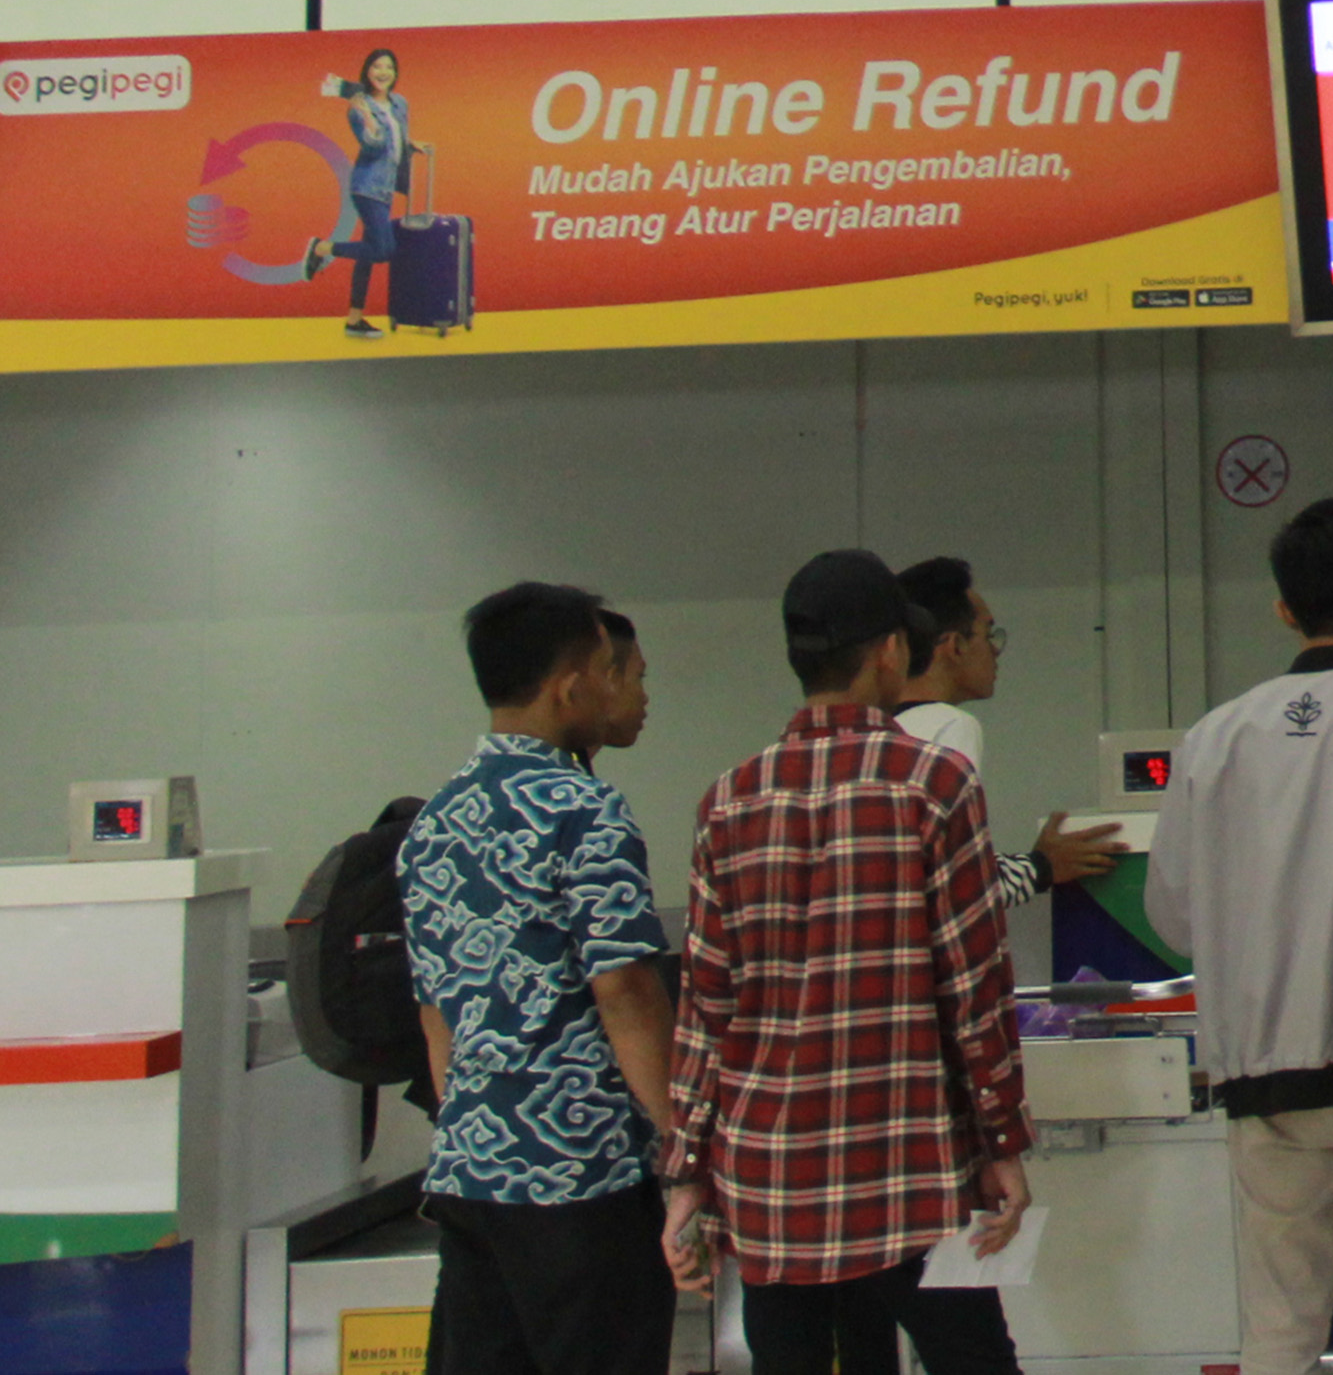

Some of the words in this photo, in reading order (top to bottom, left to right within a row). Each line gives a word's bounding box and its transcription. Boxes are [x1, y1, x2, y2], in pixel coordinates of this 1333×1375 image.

[35, 65, 183, 103] pegipegi
[531, 68, 824, 144] Online
[853, 51, 1183, 132] Refund
[529, 163, 653, 195] Mudah
[663, 159, 792, 197] Ajukan
[803, 148, 1072, 187] Pengembalian,
[530, 208, 665, 244] Tenang
[675, 204, 756, 237] Atur
[767, 199, 961, 237] Perjalanan
[1053, 288, 1089, 305] yuk!
[349, 1347, 398, 1361] MOHON
[401, 1346, 427, 1360] TID
